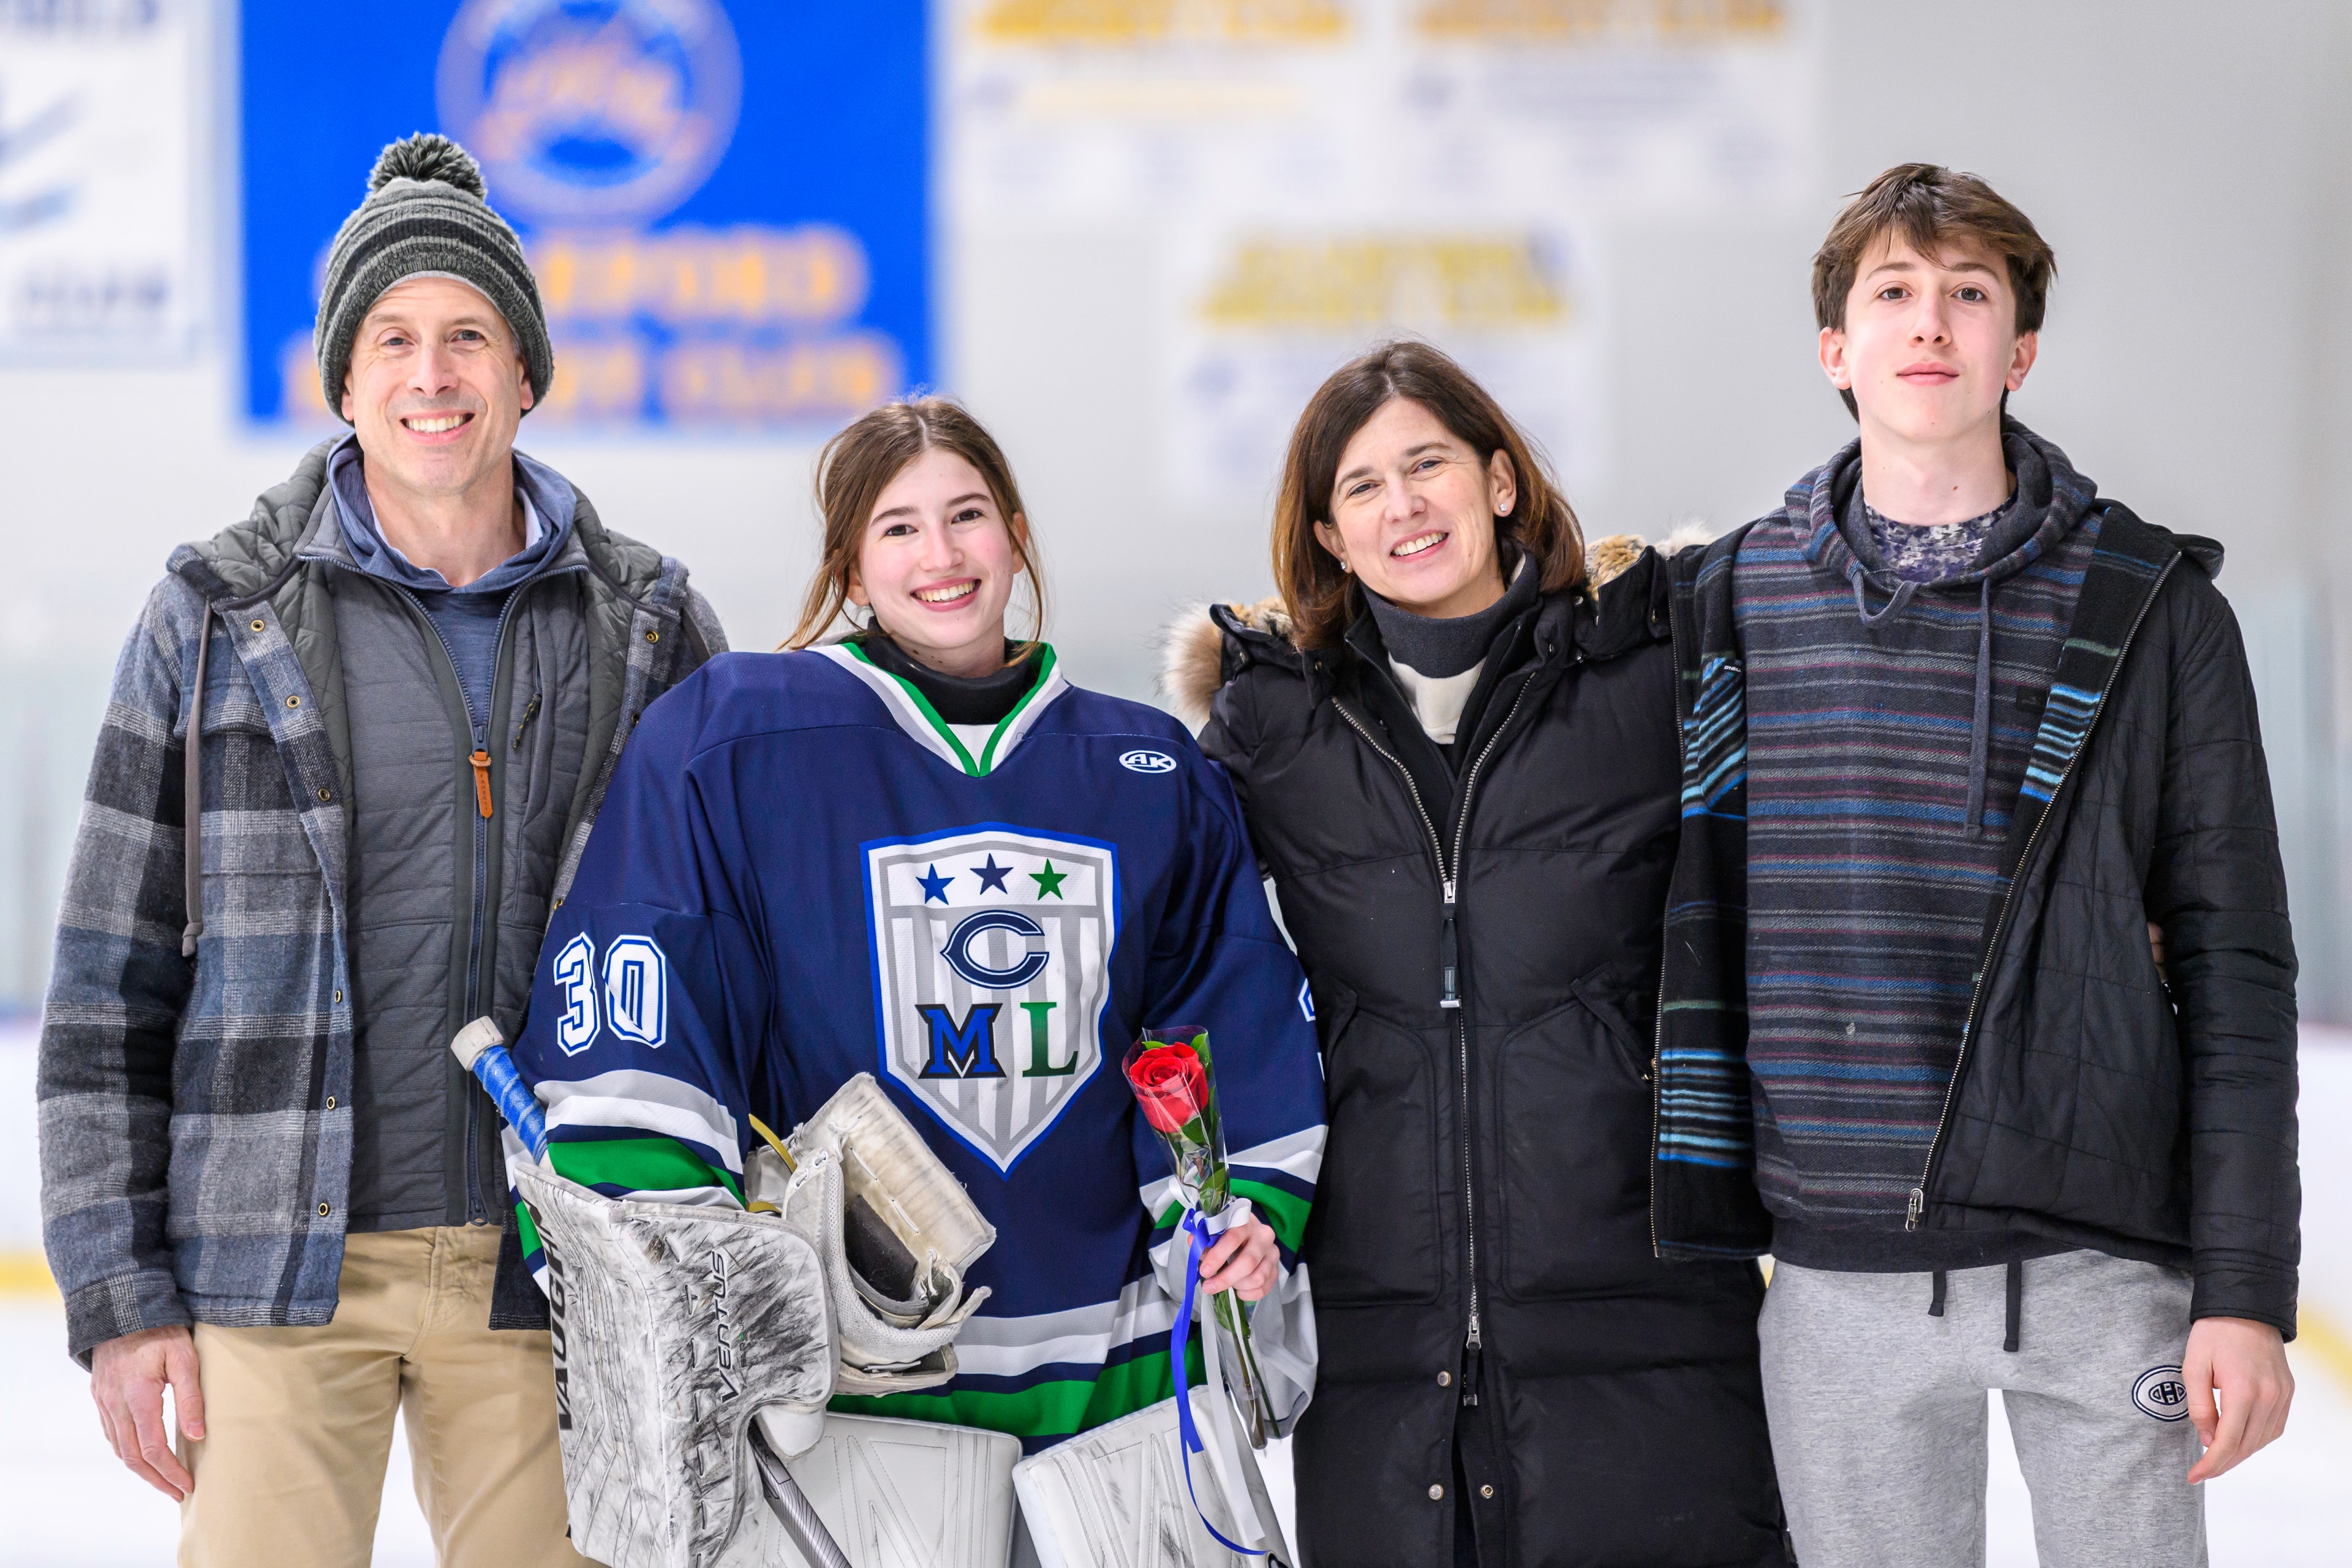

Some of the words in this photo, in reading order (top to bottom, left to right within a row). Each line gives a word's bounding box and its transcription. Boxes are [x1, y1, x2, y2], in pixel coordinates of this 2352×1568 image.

[940, 909, 1050, 989] C
[553, 931, 668, 1057] 30
[914, 1003, 1008, 1079] M
[1020, 1001, 1079, 1078] L
